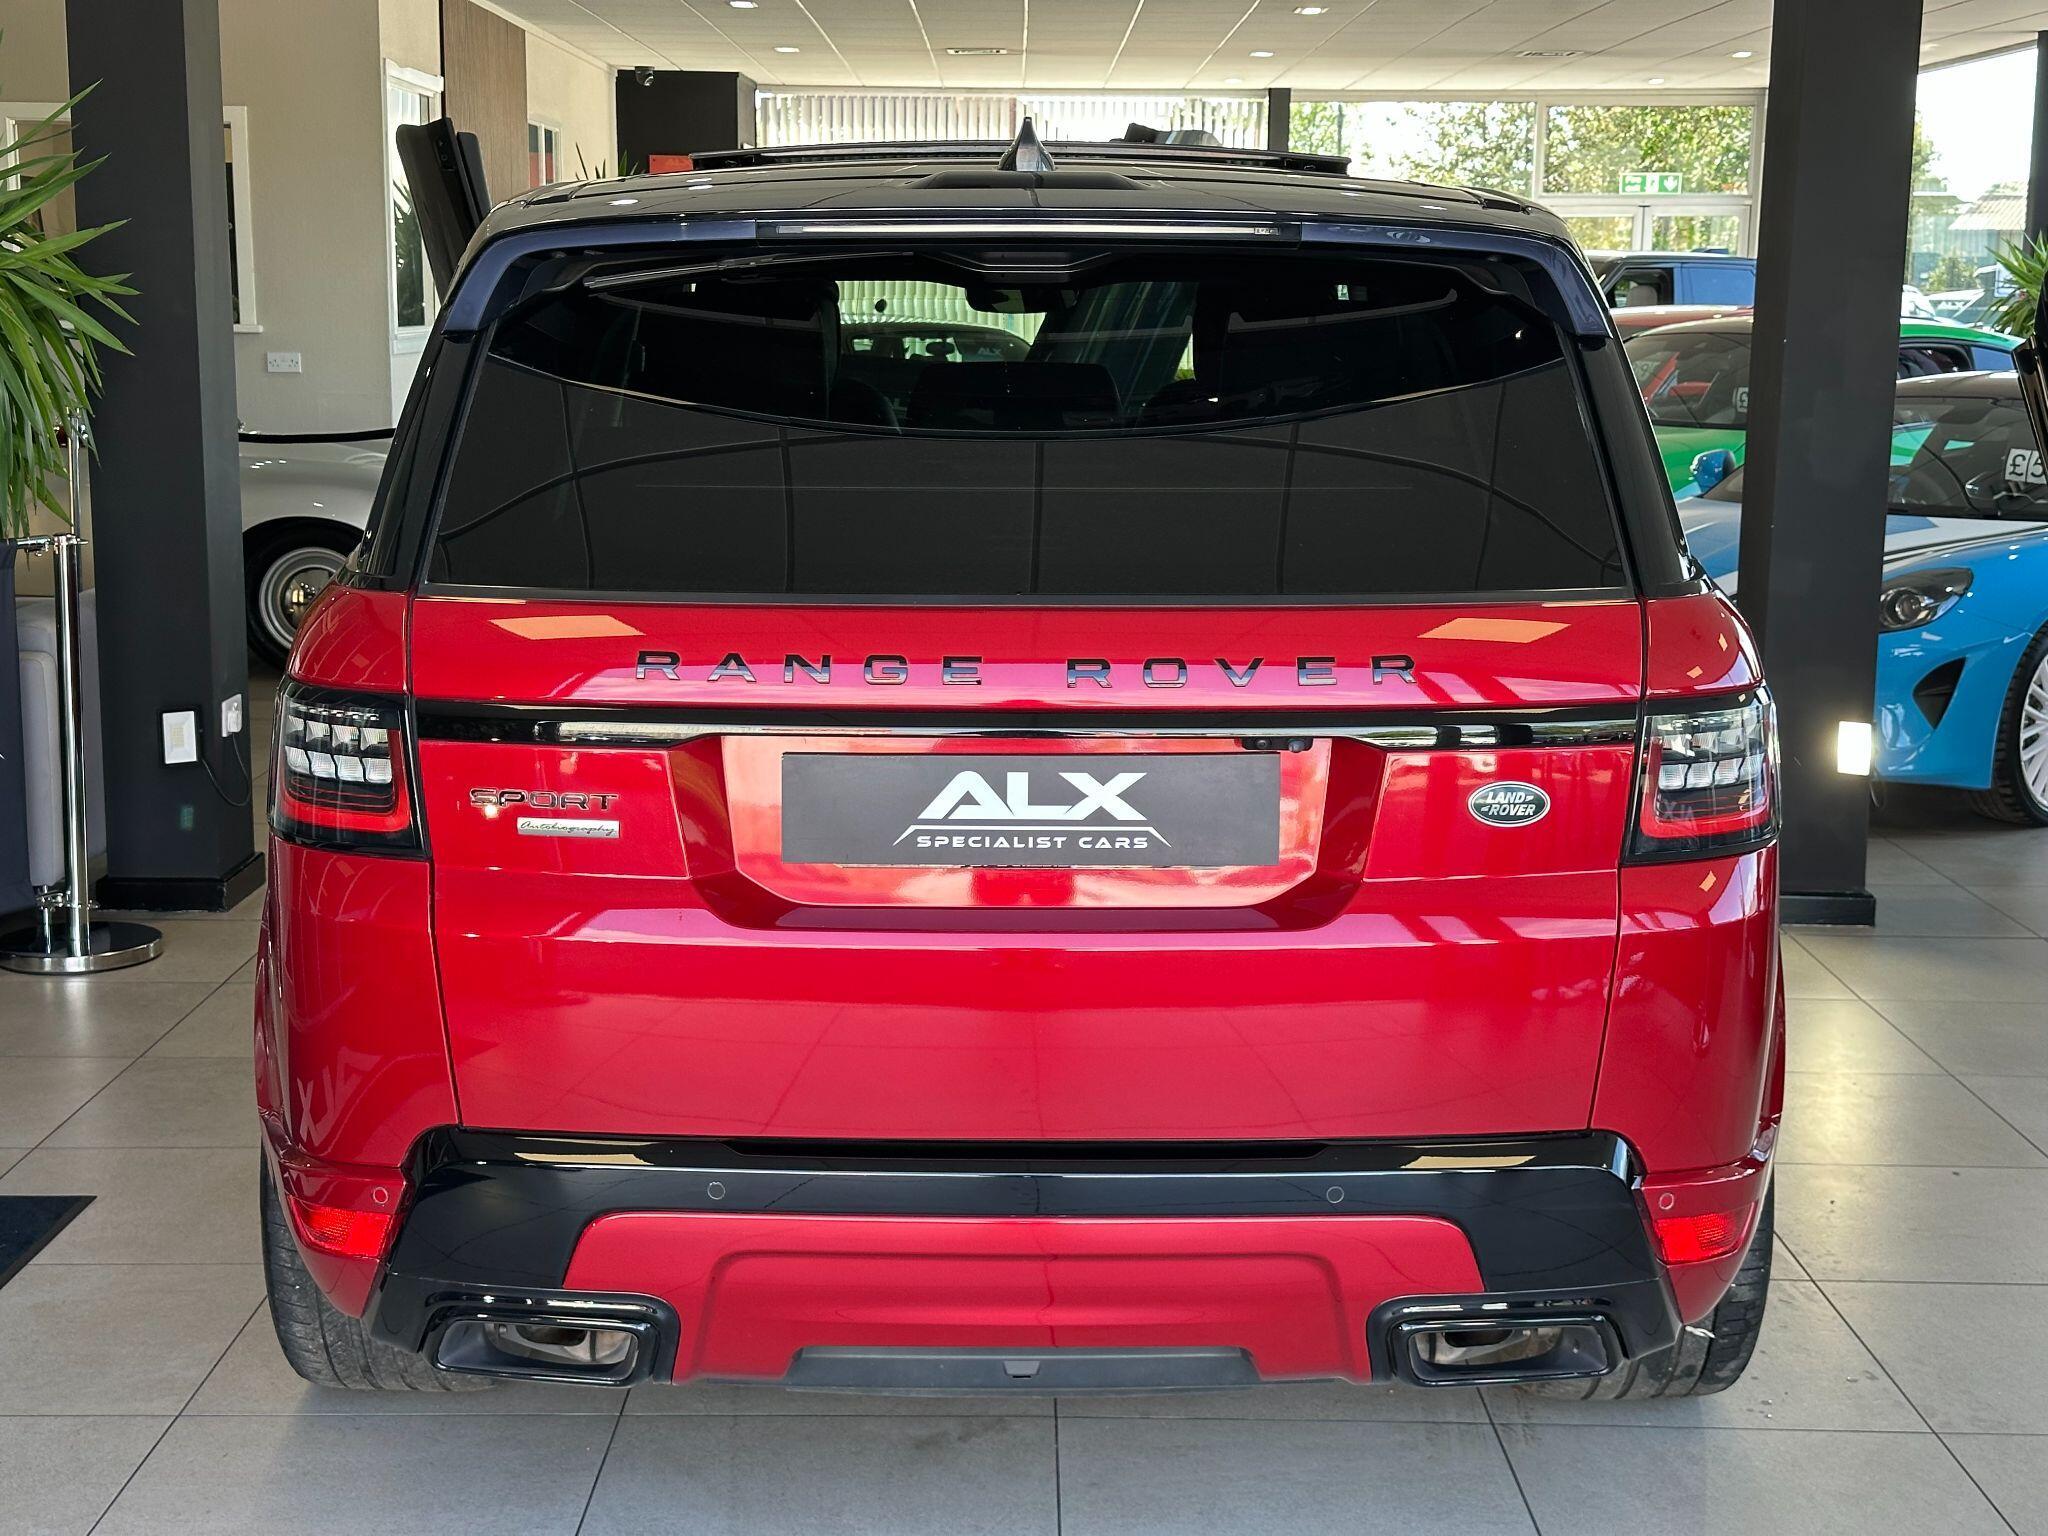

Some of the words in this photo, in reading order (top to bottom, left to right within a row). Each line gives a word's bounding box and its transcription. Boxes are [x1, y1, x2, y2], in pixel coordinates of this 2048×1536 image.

[635, 650, 984, 686] RANGE
[1066, 654, 1418, 689] ROVER
[470, 788, 618, 810] SPORT
[917, 770, 1148, 821] ALX
[1486, 791, 1526, 803] LAND
[1488, 804, 1536, 816] ROVER
[520, 820, 616, 836] Autobiography
[916, 835, 1068, 849] SPECIALIST
[1078, 836, 1149, 849] CARS
